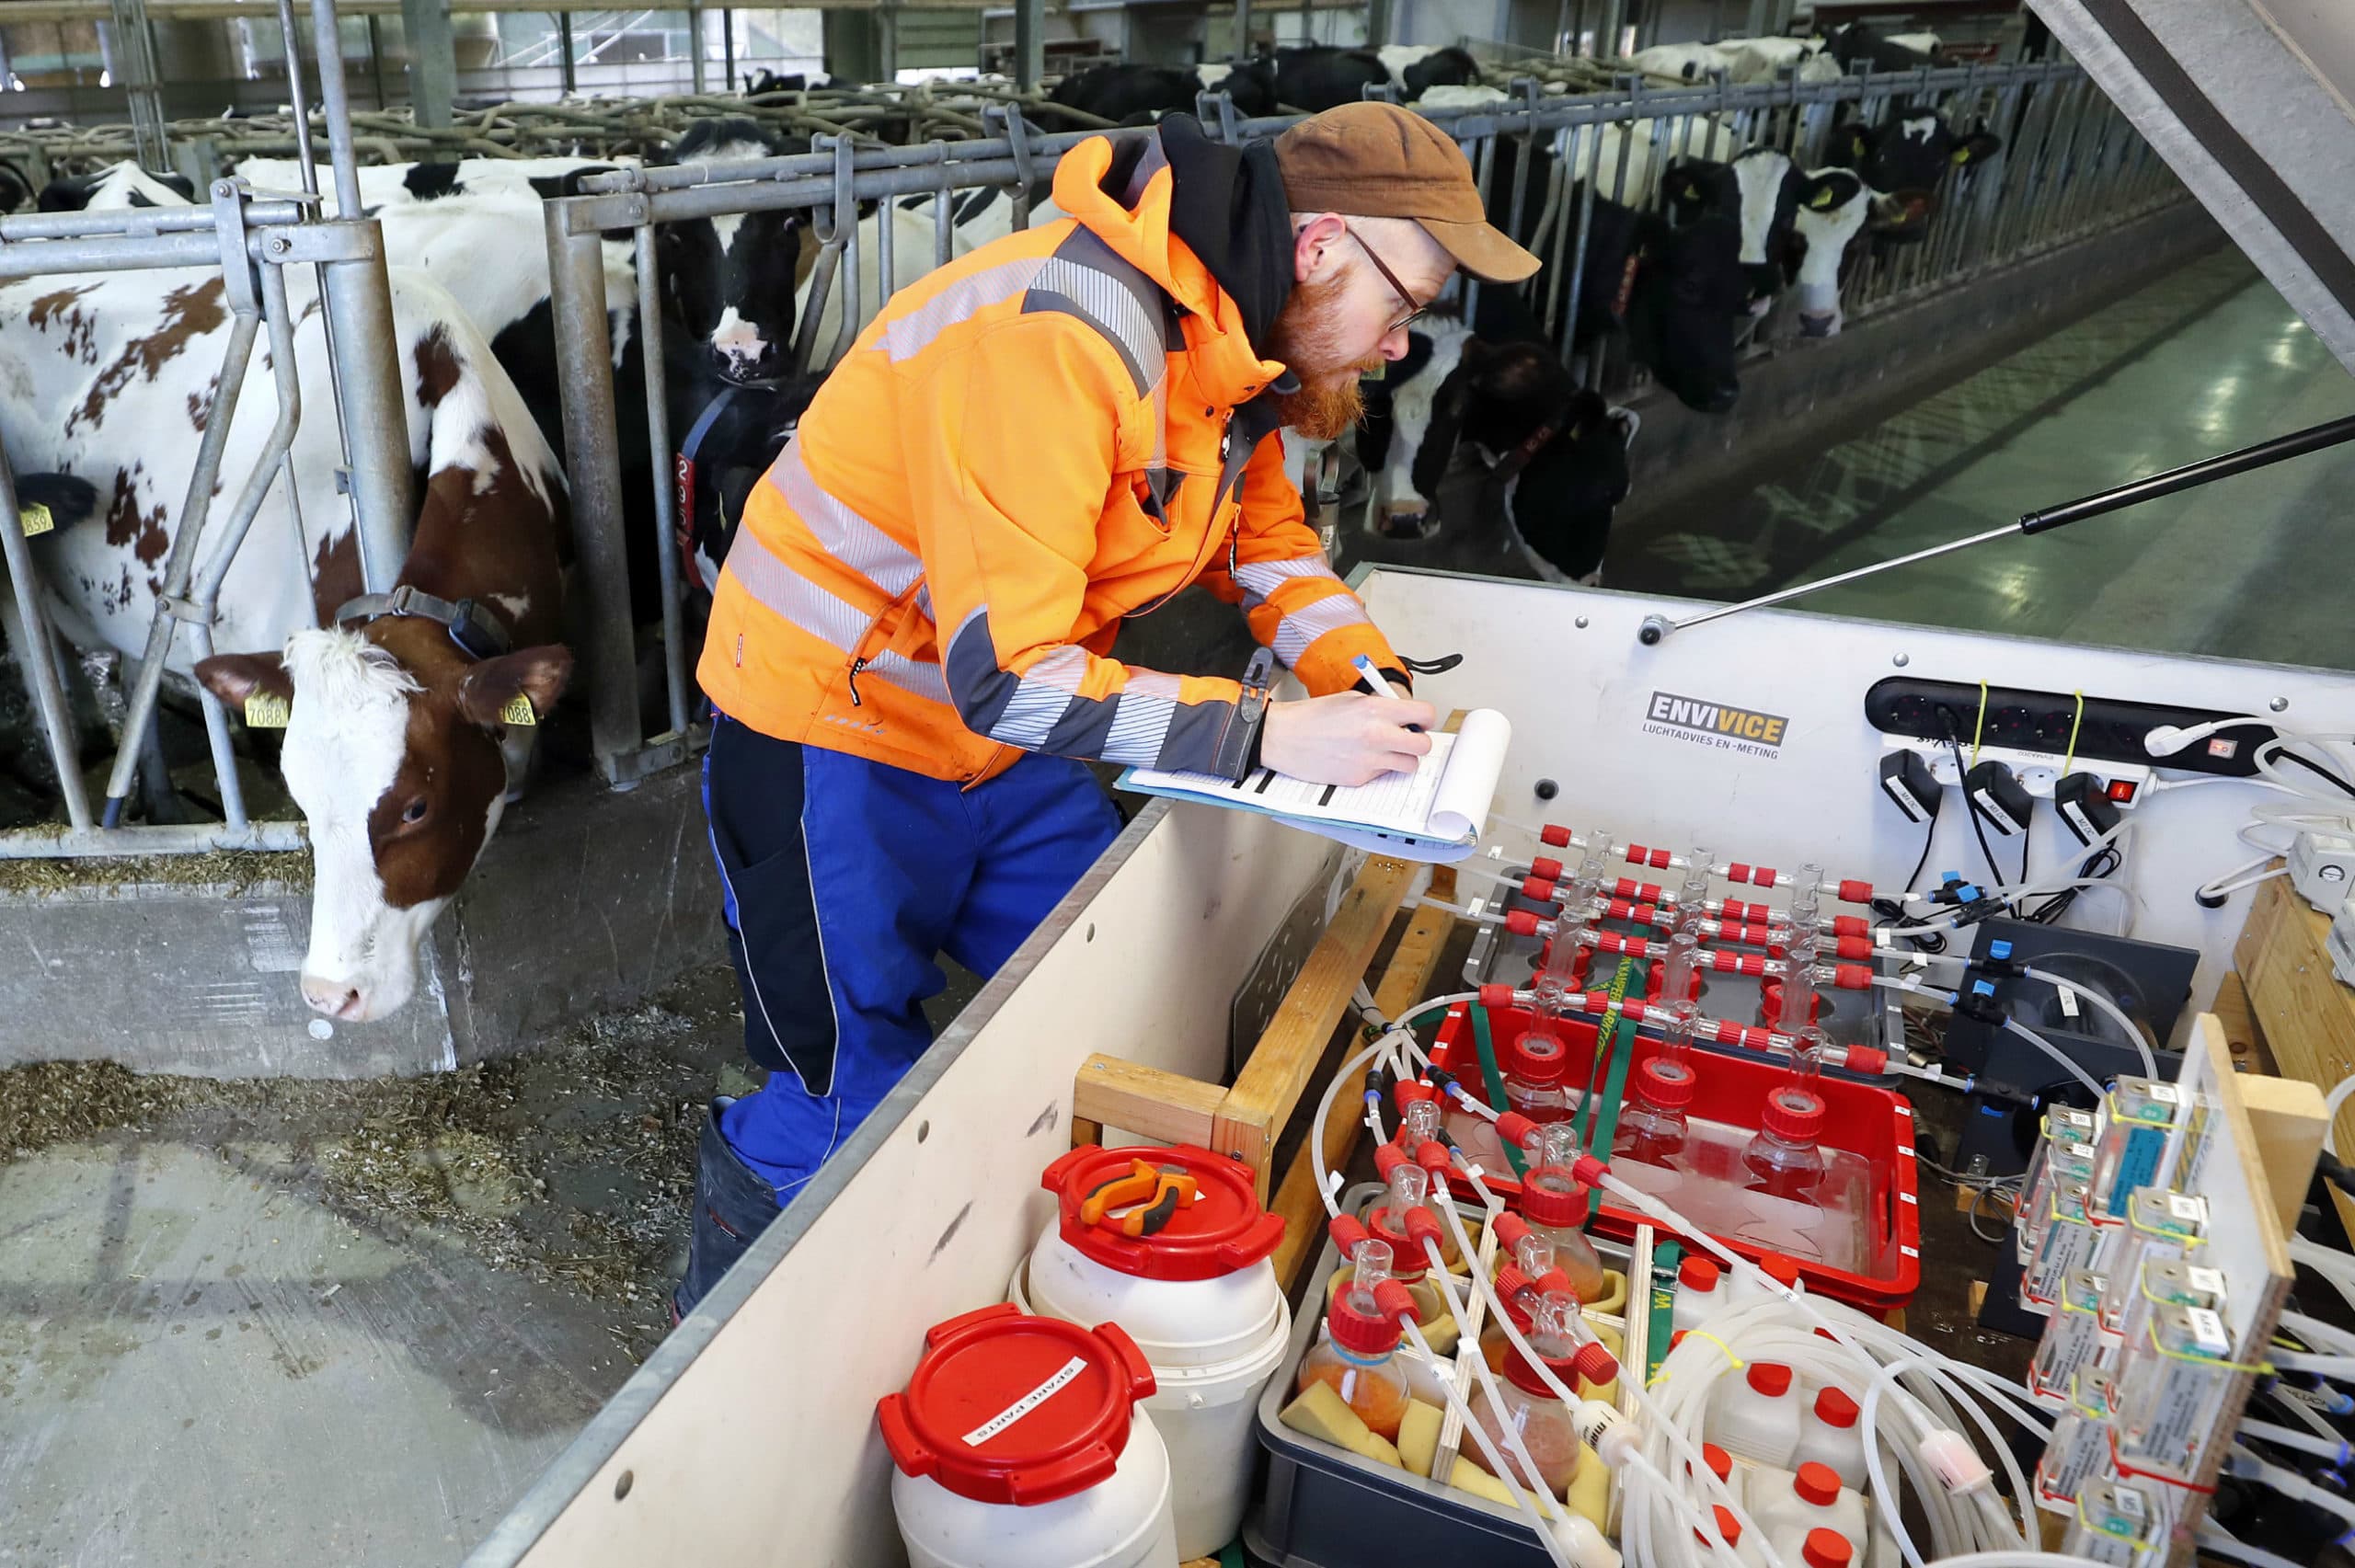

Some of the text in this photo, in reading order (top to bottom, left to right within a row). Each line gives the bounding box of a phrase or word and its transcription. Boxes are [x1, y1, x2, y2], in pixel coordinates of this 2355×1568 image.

[248, 708, 281, 726] 7088
[1650, 695, 1784, 742] ENVIVICE
[1641, 723, 1713, 746] LUCHTADVIES
[1715, 738, 1730, 750] EN
[976, 1367, 1074, 1438] SPARE PARTS
